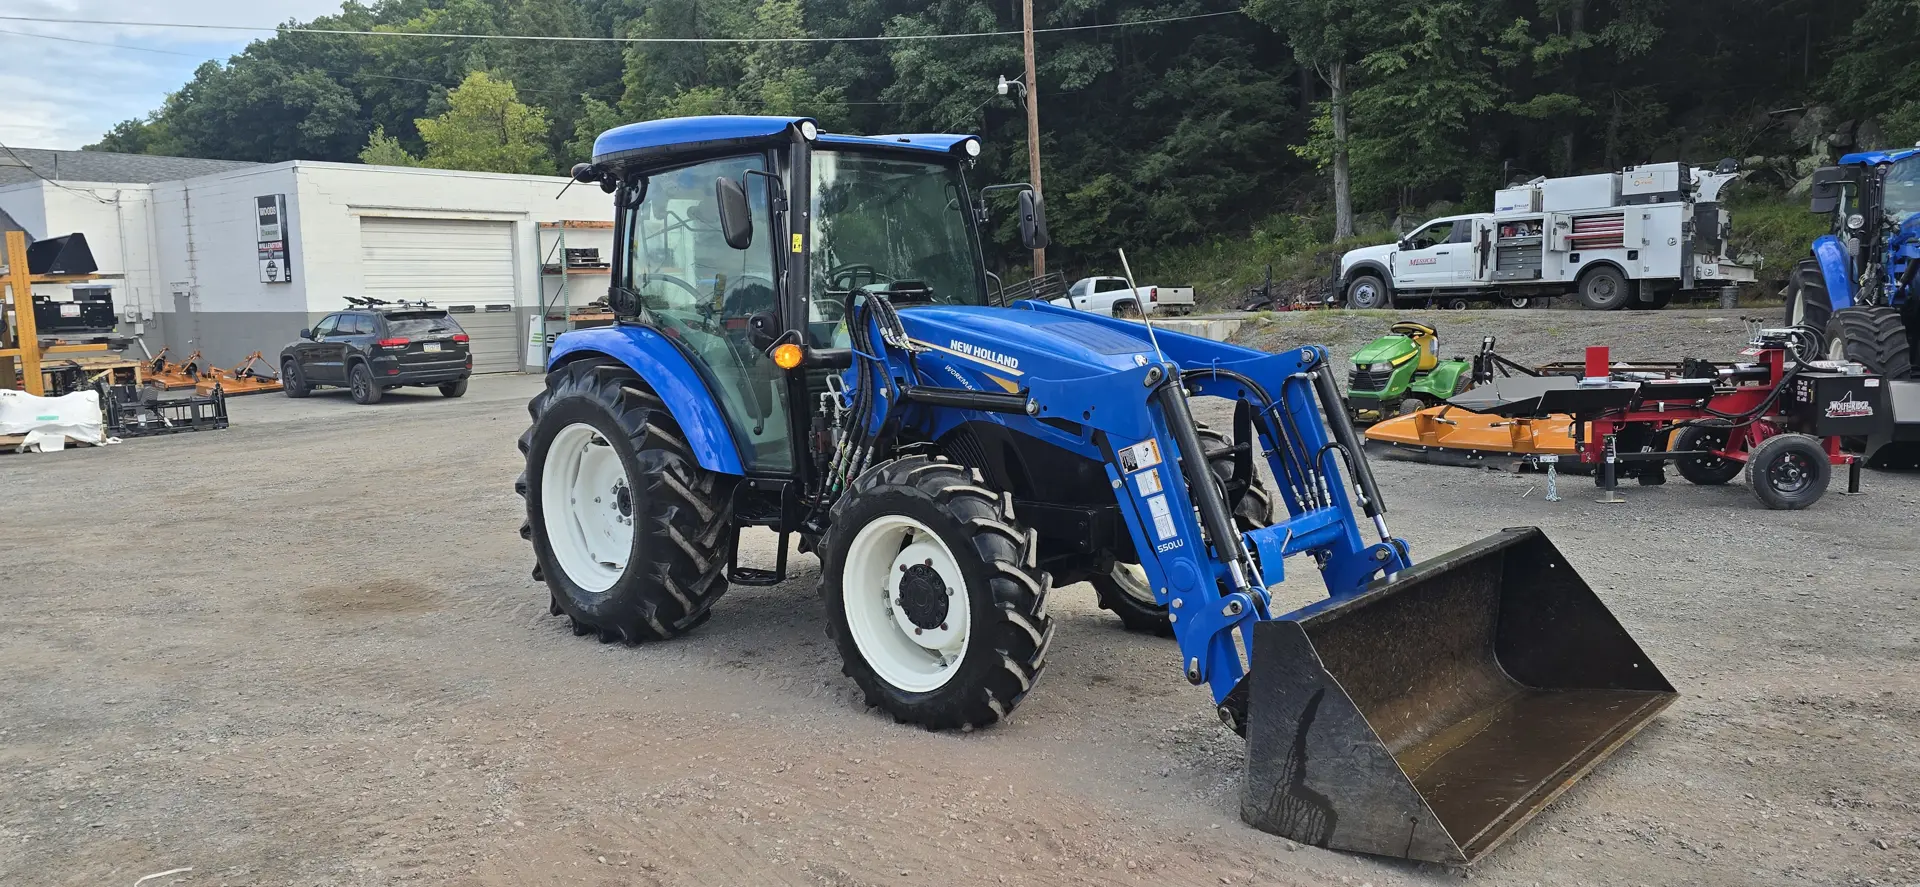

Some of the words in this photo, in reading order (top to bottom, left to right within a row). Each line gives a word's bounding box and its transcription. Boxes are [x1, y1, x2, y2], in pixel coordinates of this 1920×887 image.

[259, 206, 276, 217] WOODS
[950, 339, 972, 354] NEW
[973, 346, 1019, 369] HOLLAND
[944, 364, 976, 391] WORKMA
[1157, 538, 1184, 553] 550LU
